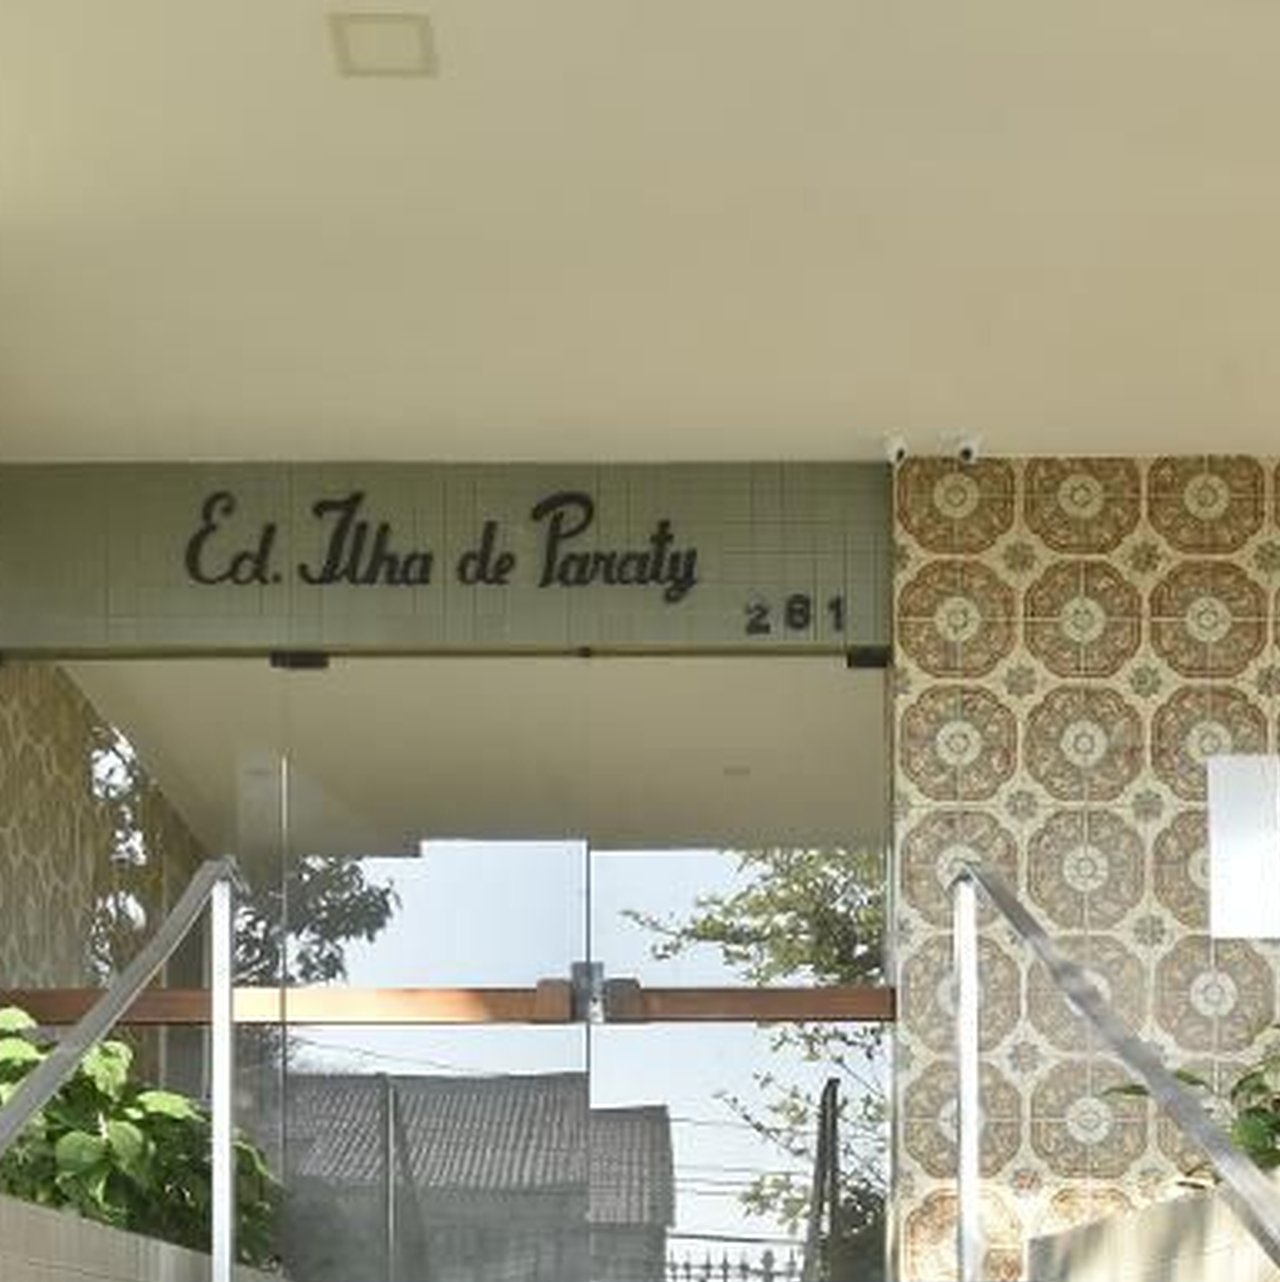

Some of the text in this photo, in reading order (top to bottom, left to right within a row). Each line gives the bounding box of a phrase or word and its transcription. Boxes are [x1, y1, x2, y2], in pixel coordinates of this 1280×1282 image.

[185, 490, 698, 604] Ed. Ilha de Paraty
